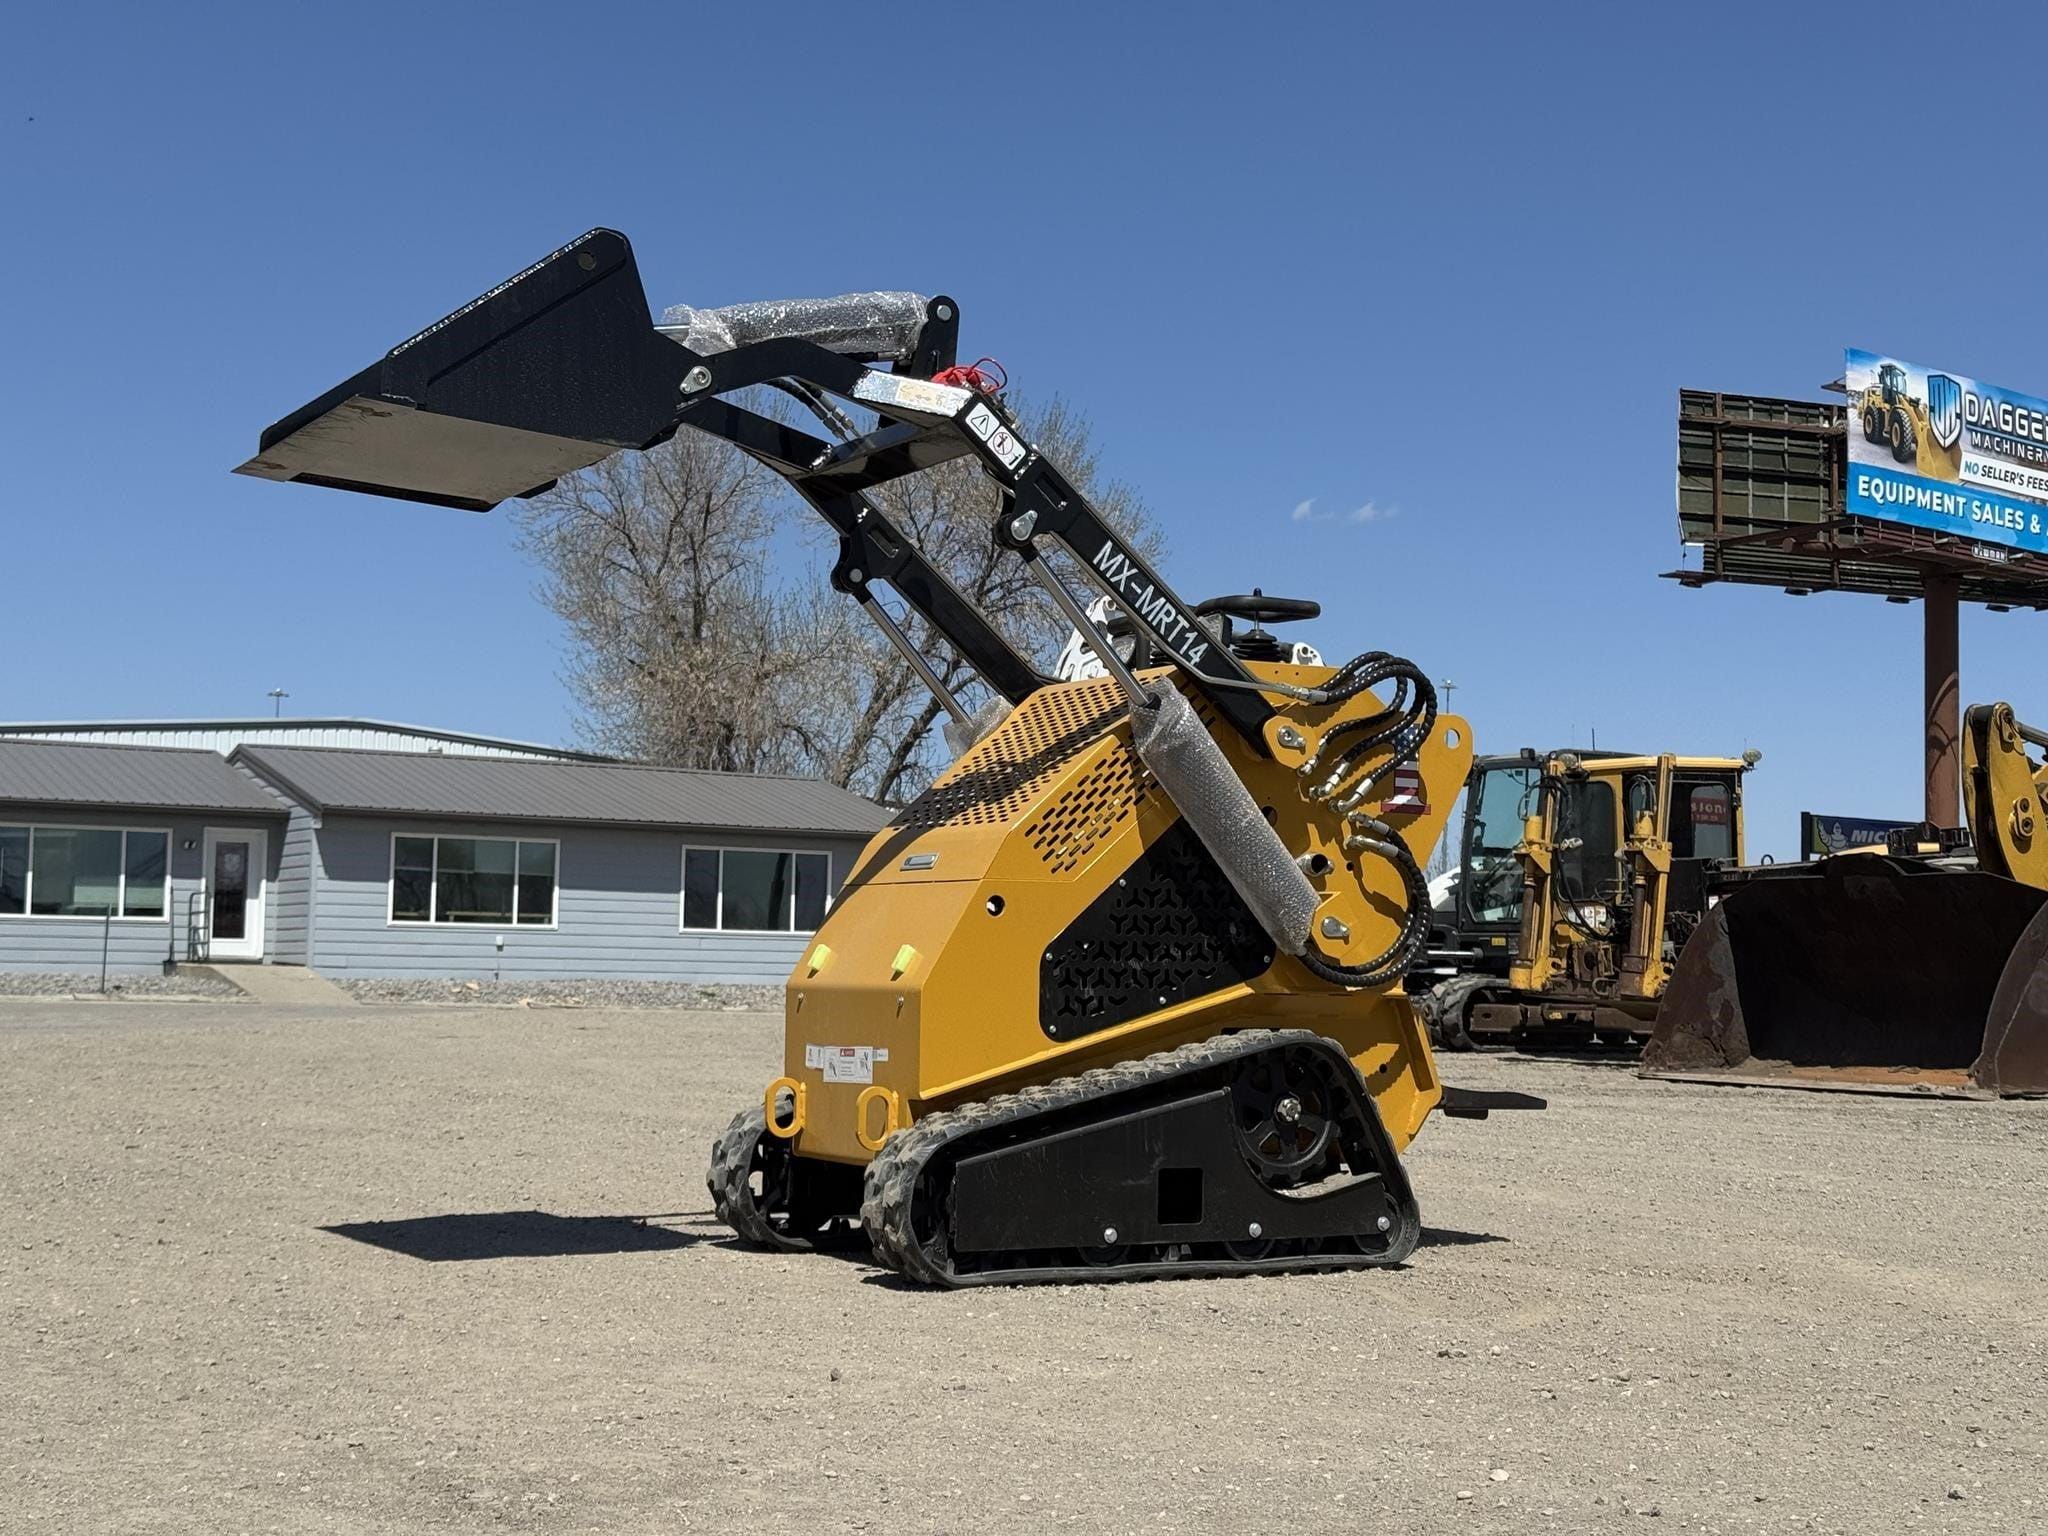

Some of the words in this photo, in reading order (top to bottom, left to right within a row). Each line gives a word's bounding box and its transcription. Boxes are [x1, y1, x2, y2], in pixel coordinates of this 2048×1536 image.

[1965, 393, 2048, 441] DAGGE
[1964, 460, 1979, 475] NO
[1981, 465, 2024, 486] SELLER'S
[2026, 476, 2048, 492] FEES
[1858, 475, 1966, 517] EQUIPMENT
[1972, 500, 2024, 531] SALES
[2030, 514, 2041, 533] &
[1092, 541, 1209, 665] MX-MRT14
